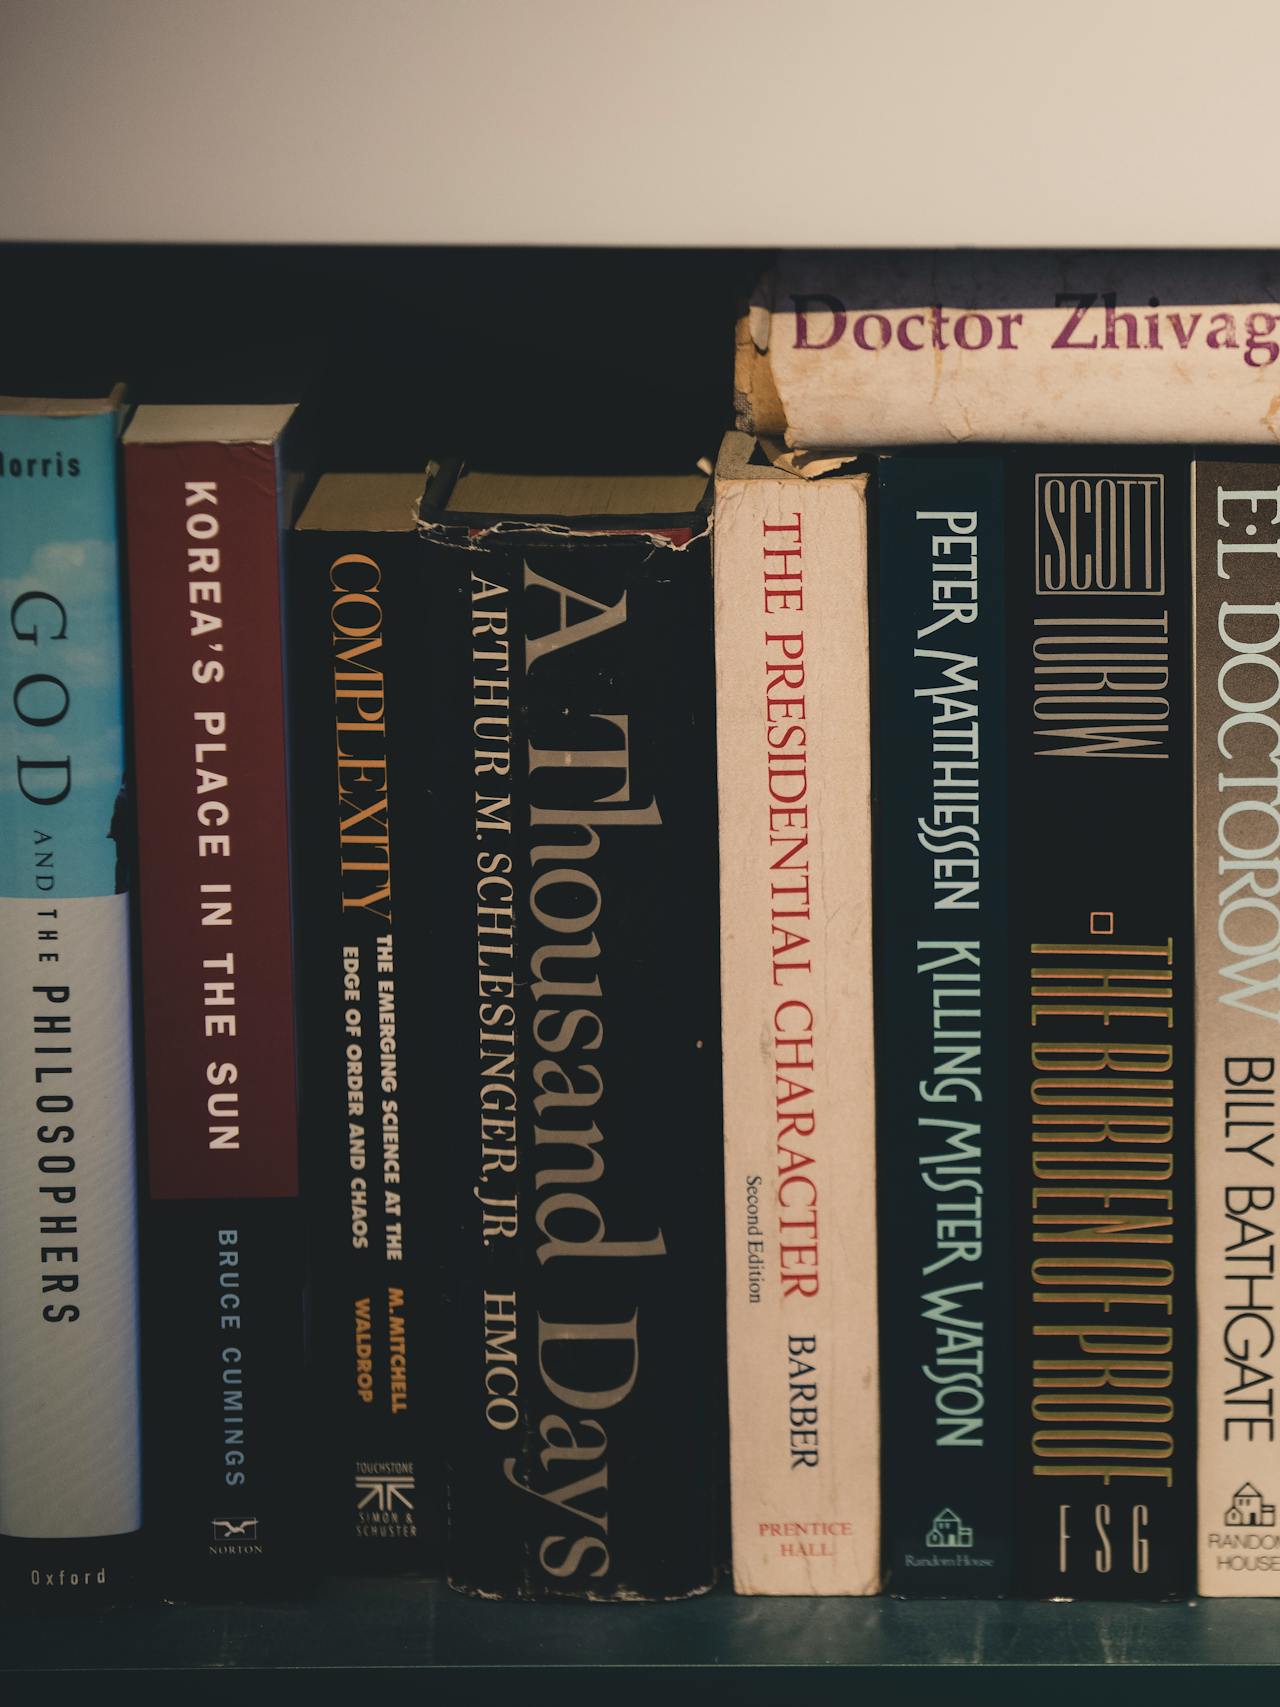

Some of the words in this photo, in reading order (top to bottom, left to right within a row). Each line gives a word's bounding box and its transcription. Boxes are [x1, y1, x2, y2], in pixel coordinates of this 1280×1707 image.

[790, 292, 1024, 351] Doctor
[0, 451, 81, 477] orris
[762, 513, 804, 614] THE
[915, 510, 979, 640] PETER
[1043, 478, 1159, 592] SCOTT
[184, 481, 225, 685] KOREA'S
[523, 559, 628, 676] A
[10, 591, 71, 806] GOD
[471, 571, 512, 777] ARTHUR
[1033, 610, 1170, 760] TUROW
[193, 712, 231, 857] PLACE
[329, 553, 393, 924] COMPLEXITY
[913, 647, 981, 911] MATTHIESSEN
[475, 791, 512, 841] M.
[764, 631, 812, 986] PRESIDENTIAL
[33, 829, 55, 892] AND
[200, 883, 233, 927] IN
[37, 909, 59, 962] THE
[343, 946, 361, 1001] EDGE
[376, 934, 394, 973] THE
[1031, 936, 1174, 1029] THE
[202, 953, 237, 1038] THE
[345, 1008, 362, 1037] OF
[378, 980, 398, 1093] EMERGING
[527, 714, 667, 1266] Thousand
[916, 940, 983, 1103] KILLING
[206, 1062, 241, 1151] SUN
[346, 1044, 365, 1116] ORDER
[1224, 1056, 1275, 1168] BILLY
[33, 984, 81, 1325] PHILOSOPHERS
[349, 1123, 366, 1171] AND
[382, 1100, 400, 1184] SCIENCE
[772, 1000, 821, 1299] CHARACTER
[1031, 1041, 1175, 1244] BURDEN
[351, 1177, 368, 1249] CHAOS
[385, 1190, 401, 1216] AT
[386, 1223, 403, 1261] THE
[473, 1186, 518, 1248] JR.
[745, 1175, 765, 1237] Second
[917, 1116, 984, 1276] MISTER
[218, 1229, 241, 1330] BRUCE
[388, 1287, 404, 1313] M.
[747, 1240, 767, 1304] Edition
[1031, 1258, 1175, 1316] OF
[1223, 1186, 1275, 1442] BATHGATE
[355, 1298, 373, 1403] WALDROP
[389, 1316, 407, 1414] MITCHELL
[483, 1290, 519, 1431] HMCO
[920, 1281, 985, 1447] WATSON
[221, 1347, 246, 1487] CUMINGS
[503, 1305, 639, 1579] Days
[787, 1334, 820, 1471] BARBER
[1031, 1325, 1175, 1488] PROOF
[355, 1461, 414, 1474] TOUCHSTONE
[208, 1544, 264, 1555] NORTON
[355, 1525, 416, 1537] SCHUSTER
[759, 1522, 853, 1538] PRENTICE
[780, 1542, 833, 1557] HALL
[905, 1553, 956, 1568] Random
[957, 1553, 995, 1568] House
[30, 1568, 107, 1588] Oxford
